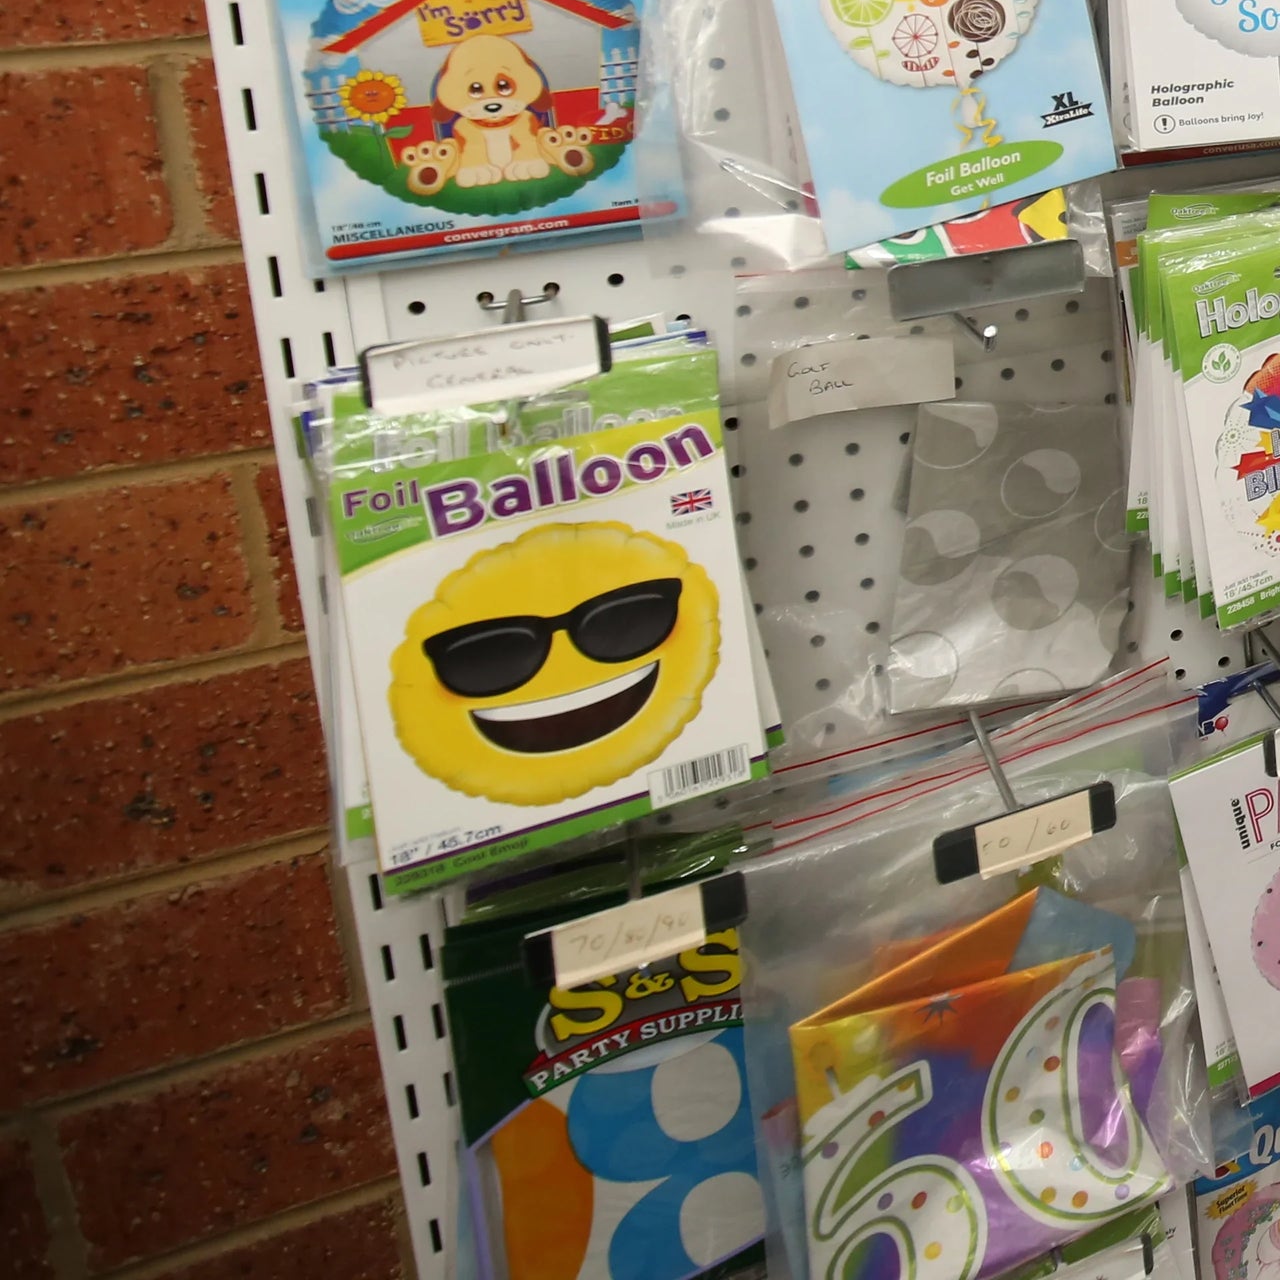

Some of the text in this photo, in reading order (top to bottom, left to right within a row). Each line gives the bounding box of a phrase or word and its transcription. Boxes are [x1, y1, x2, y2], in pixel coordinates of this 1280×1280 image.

[415, 2, 453, 23] I'm
[1150, 78, 1235, 96] Holographic
[1051, 91, 1079, 111] XL
[1151, 93, 1205, 107] Balloon
[1043, 106, 1090, 126] XtraLife
[1178, 111, 1265, 127] Balloons bring Joy!
[925, 150, 1021, 187] Foil Balloon
[950, 174, 1004, 197] Get Well
[332, 219, 456, 244] MISCELLANEOUS
[443, 218, 569, 244] convergram.com
[809, 378, 853, 394] BALL
[341, 423, 718, 539] Foil Balloon
[1230, 798, 1252, 851] unique
[528, 1001, 744, 1094] PARTY SUPPLI
